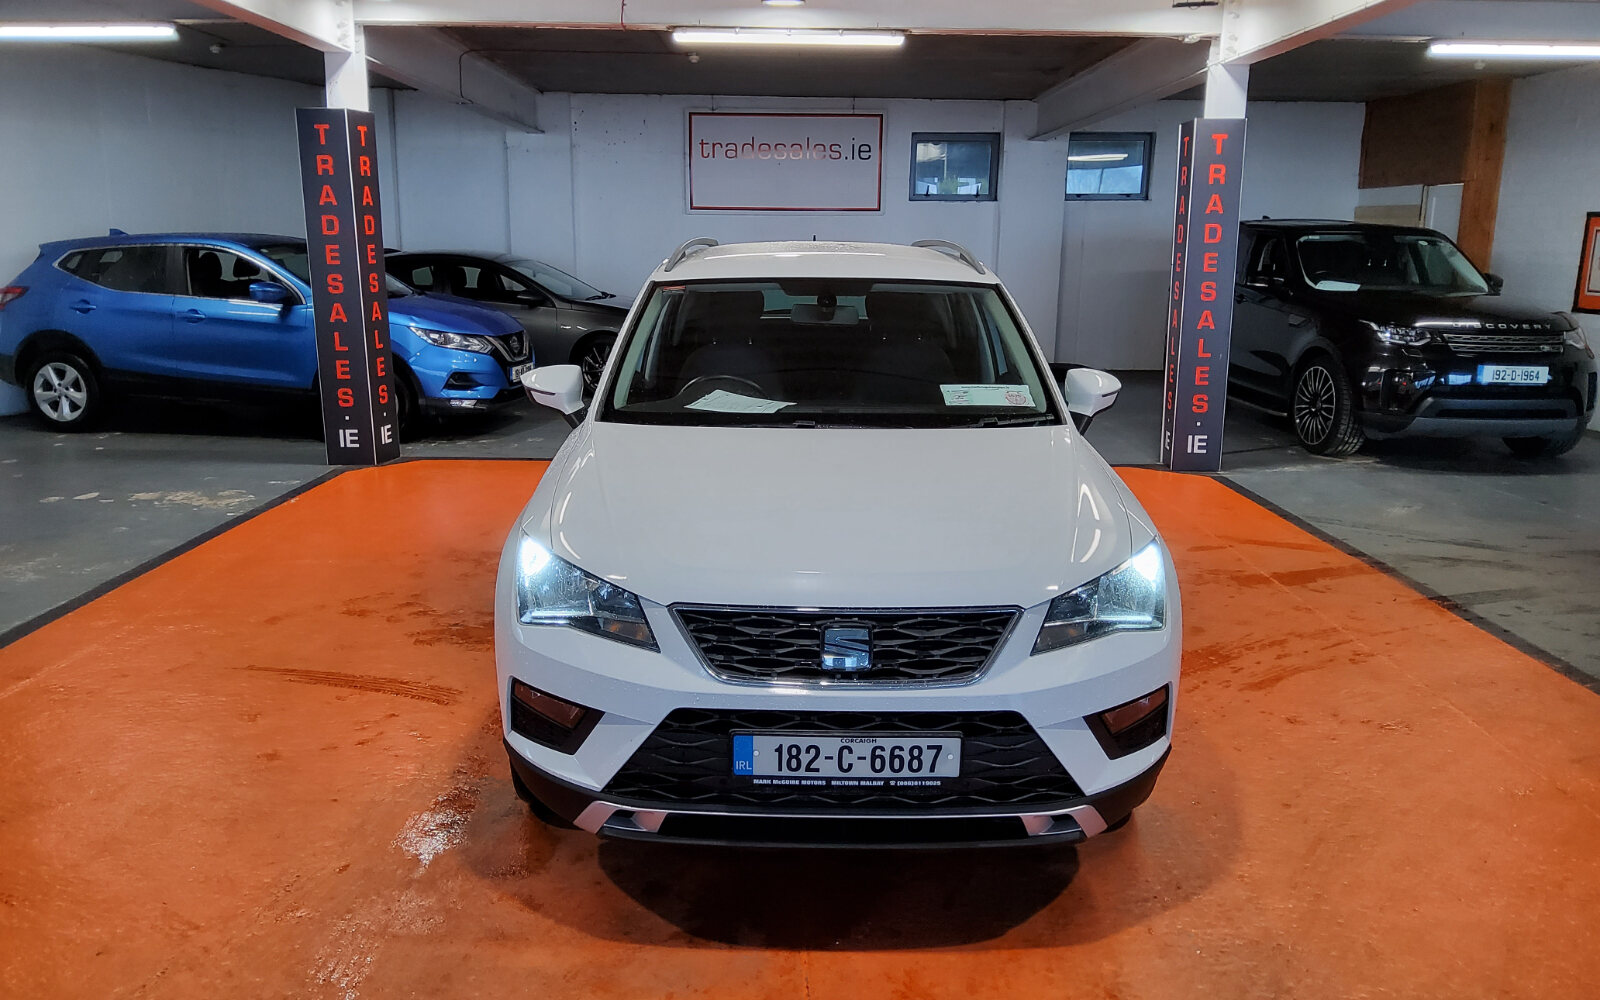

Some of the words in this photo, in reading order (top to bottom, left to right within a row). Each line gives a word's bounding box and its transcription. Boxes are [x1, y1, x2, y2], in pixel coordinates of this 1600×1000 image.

[698, 135, 872, 161] tradesales.ie
[1452, 322, 1552, 330] DISCOVERY
[1492, 369, 1540, 381] 192-D-1964
[774, 743, 943, 774] 182-C-6687
[735, 760, 752, 770] IRL
